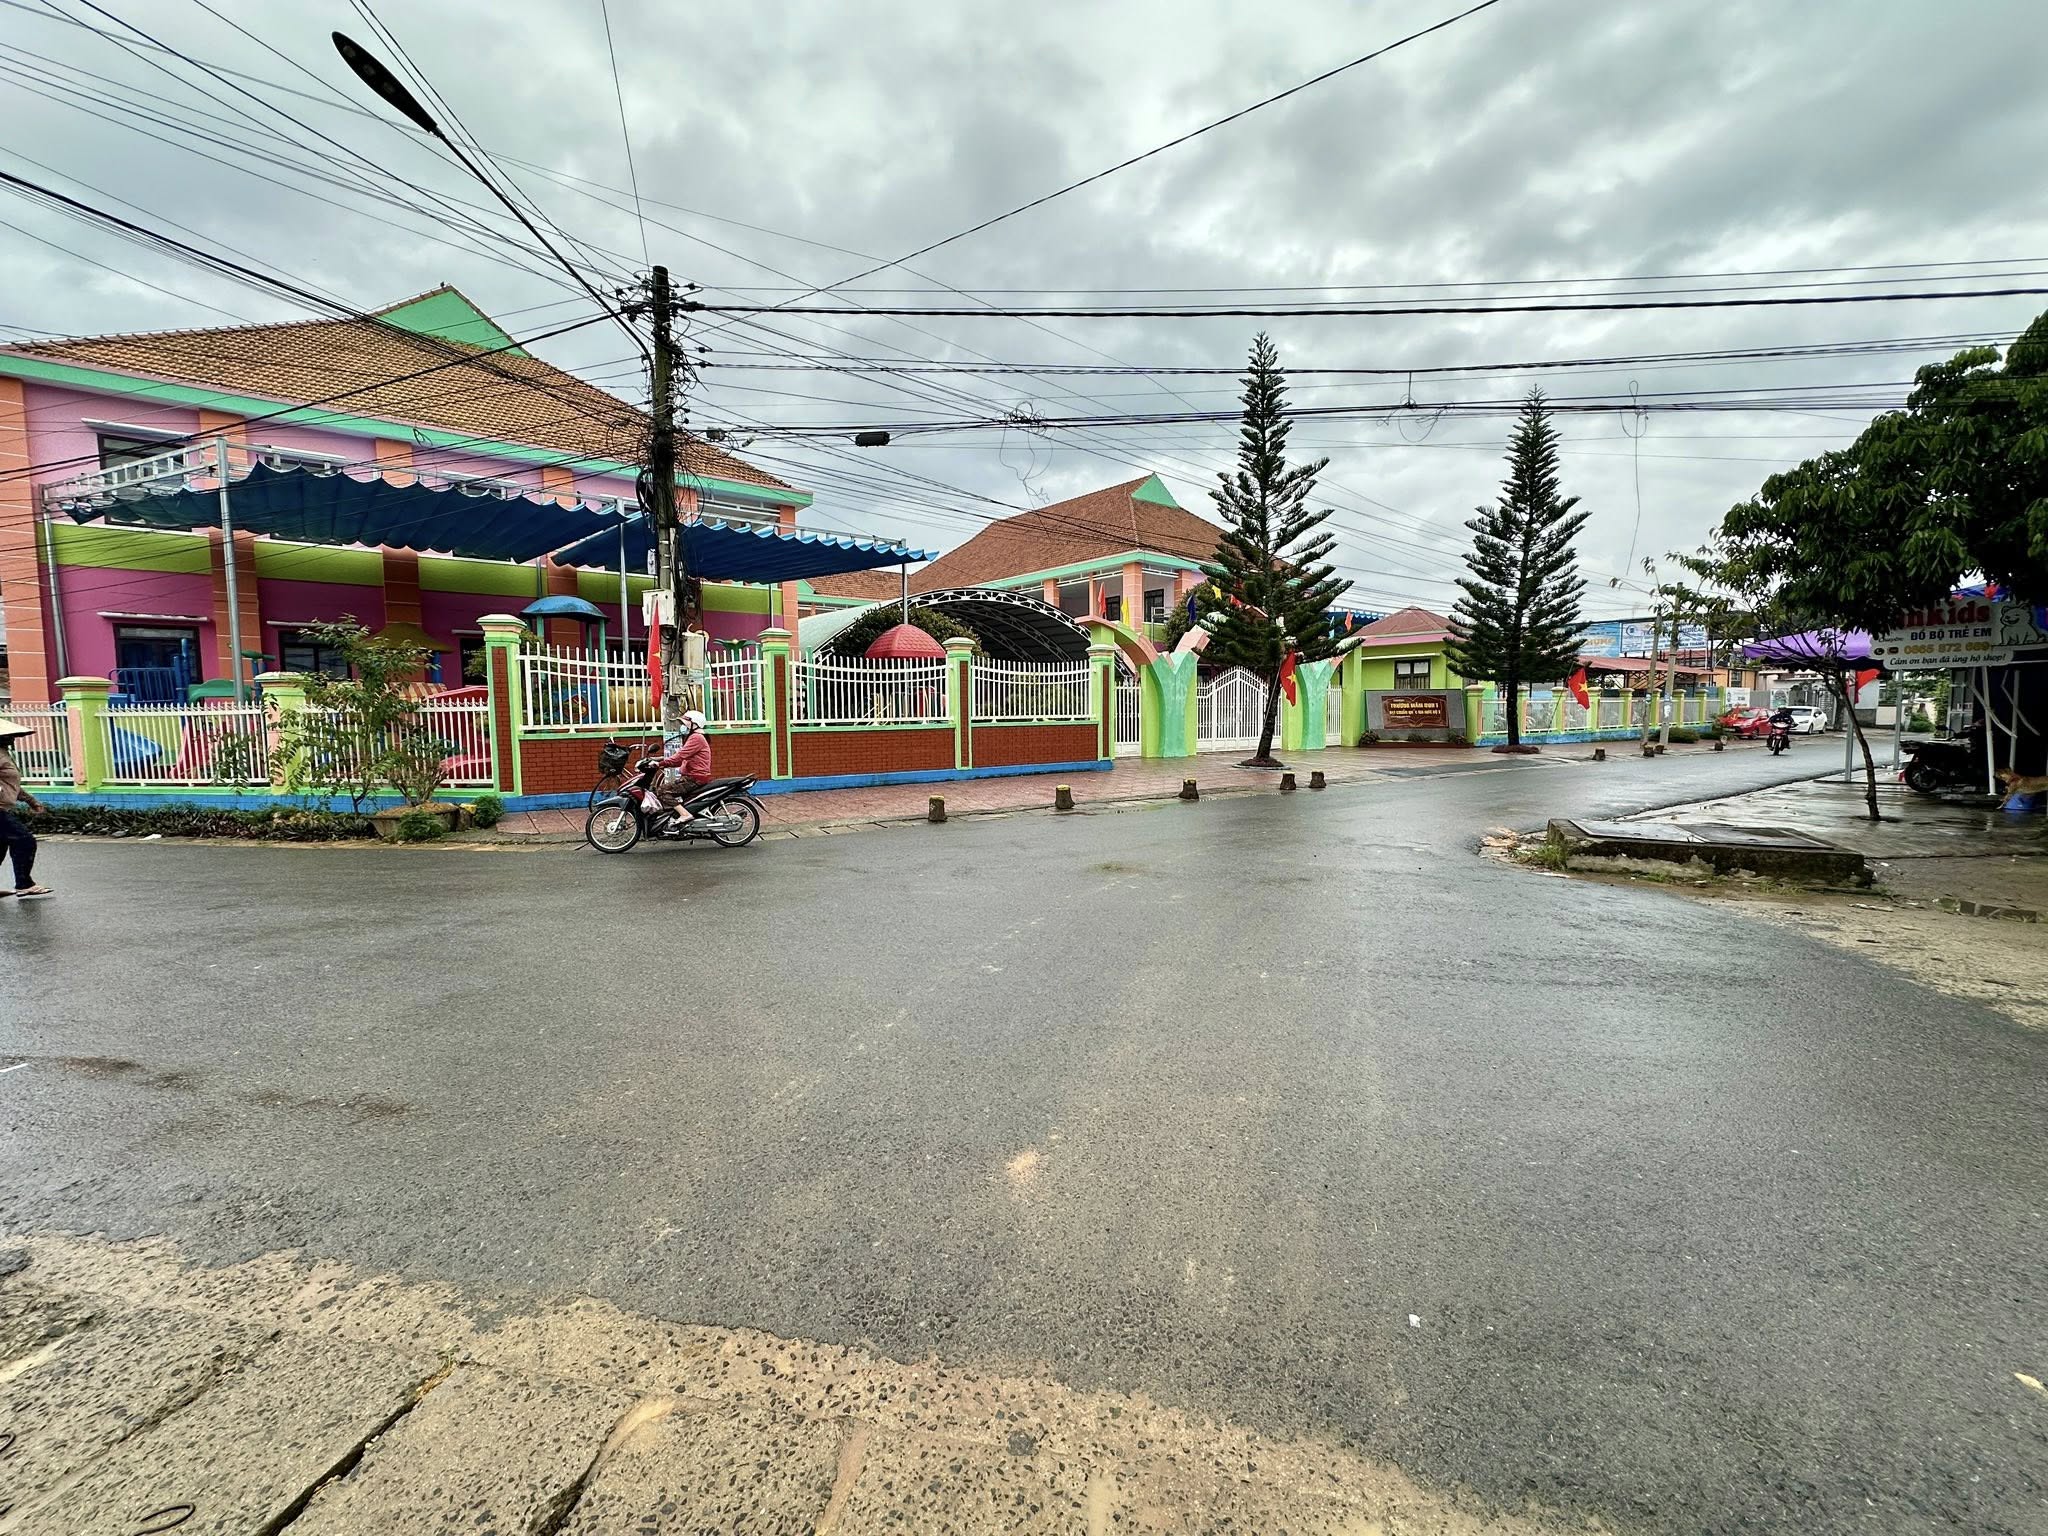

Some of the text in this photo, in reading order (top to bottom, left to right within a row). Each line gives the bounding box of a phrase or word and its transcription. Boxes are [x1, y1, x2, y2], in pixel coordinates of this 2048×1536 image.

[1929, 630, 1945, 641] BỘ
[1949, 625, 1969, 639] TRẺ
[1973, 627, 1993, 637] EM
